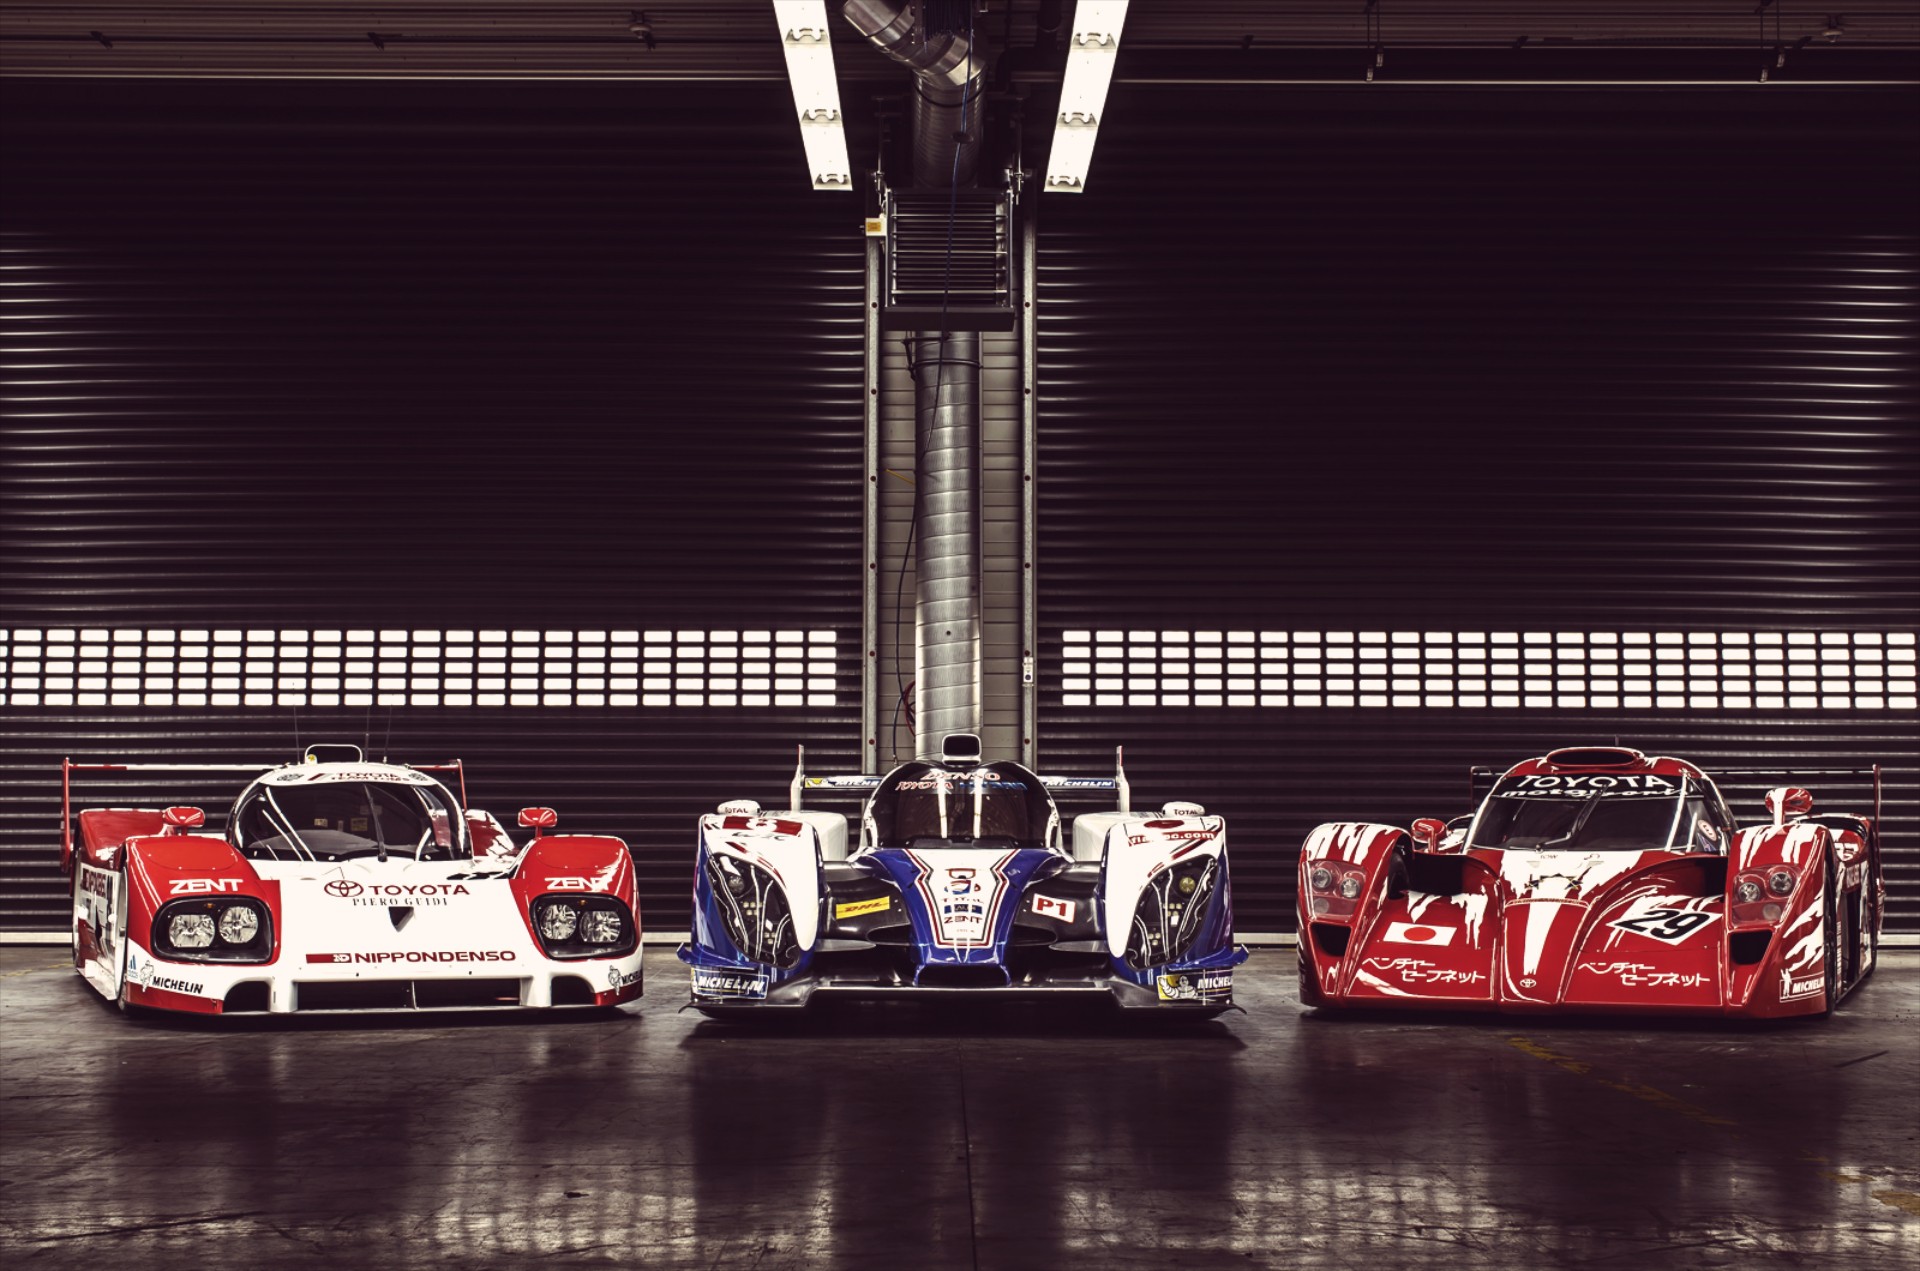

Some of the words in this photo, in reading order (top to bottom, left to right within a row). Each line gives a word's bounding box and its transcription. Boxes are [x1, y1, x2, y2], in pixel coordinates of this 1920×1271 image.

[1045, 780, 1113, 788] MICHELIN
[1516, 775, 1674, 788] TOYOTA
[169, 878, 243, 894] ZENT
[369, 884, 470, 896] TOYOTA
[353, 897, 398, 907] PIERO
[404, 896, 448, 906] GUIDI
[1036, 899, 1067, 917] P1
[1616, 909, 1710, 939] 29
[355, 951, 516, 963] NIPPONDENSO
[1362, 958, 1436, 970] ベンチャー
[1578, 962, 1656, 974] ベンチャー
[698, 975, 766, 992] MICHELIN
[1401, 969, 1486, 984] セーフネット
[1620, 972, 1710, 987] セーフネット
[152, 976, 203, 994] MICHELIN
